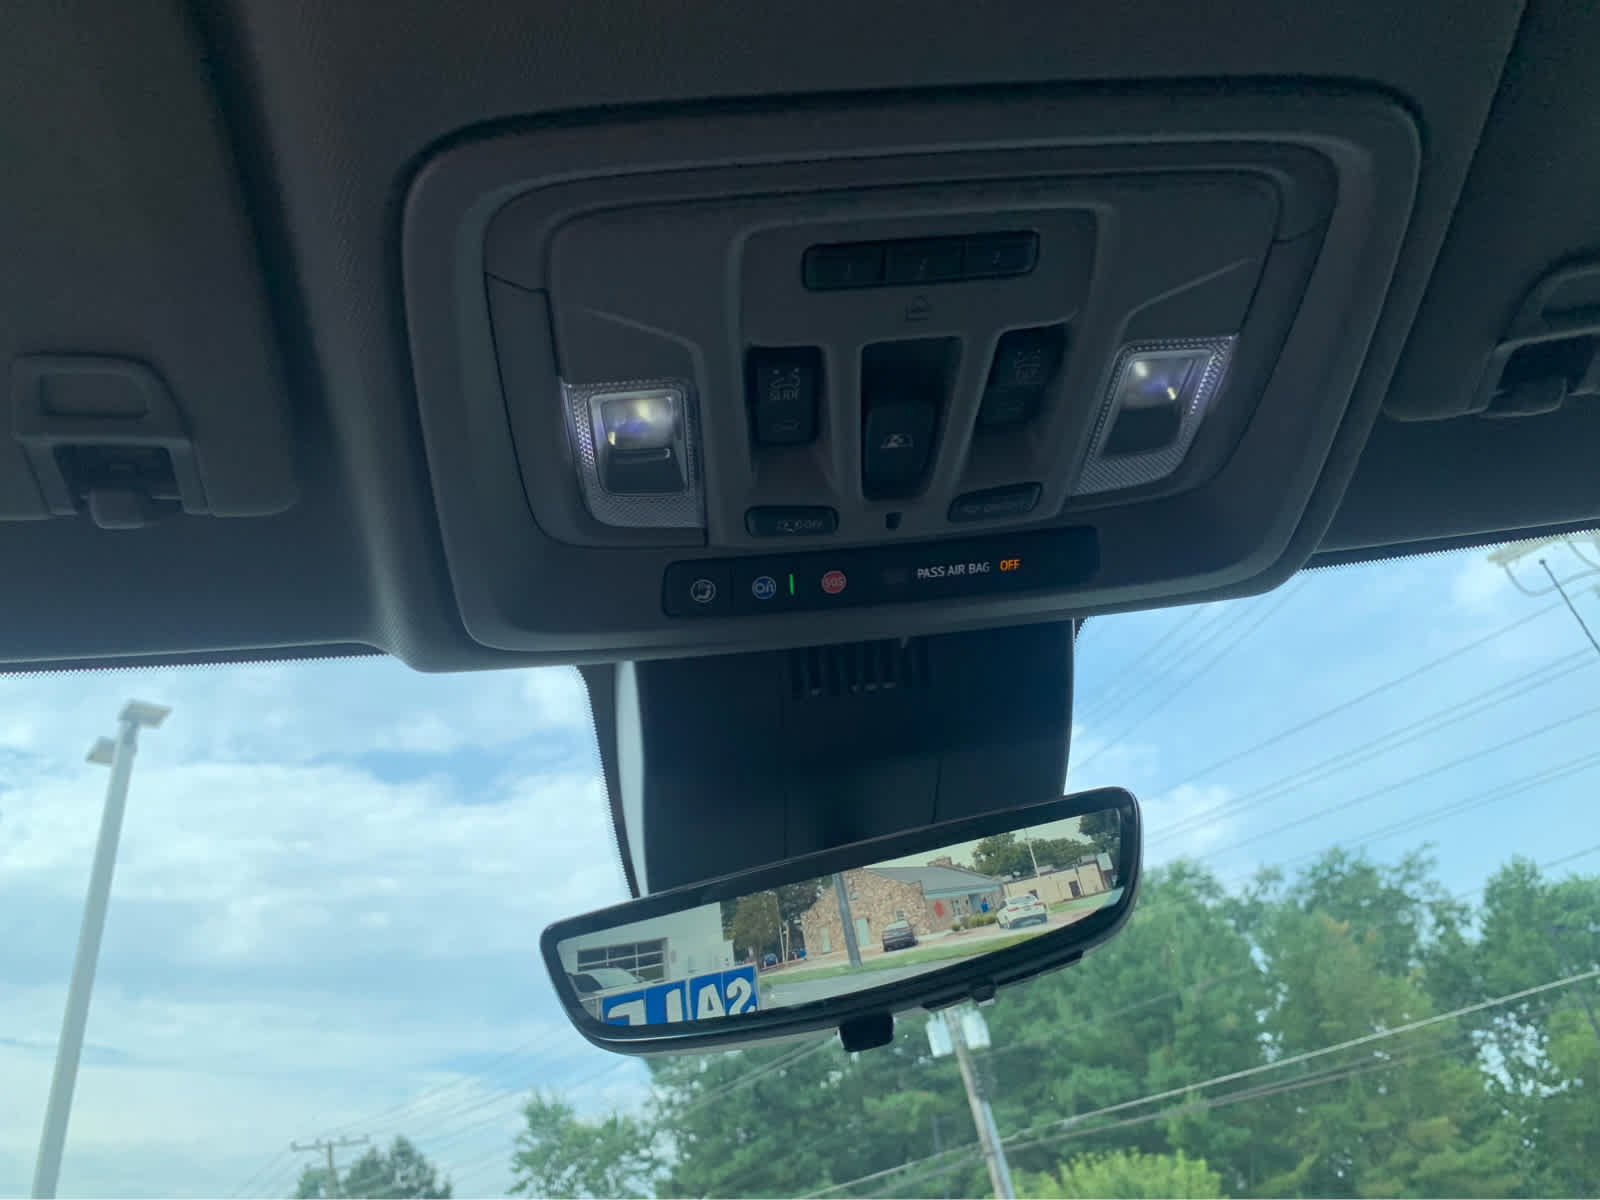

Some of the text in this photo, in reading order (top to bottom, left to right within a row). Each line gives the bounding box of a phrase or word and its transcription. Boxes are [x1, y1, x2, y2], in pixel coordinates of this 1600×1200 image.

[916, 558, 1020, 579] PASS AIR BAG OFF
